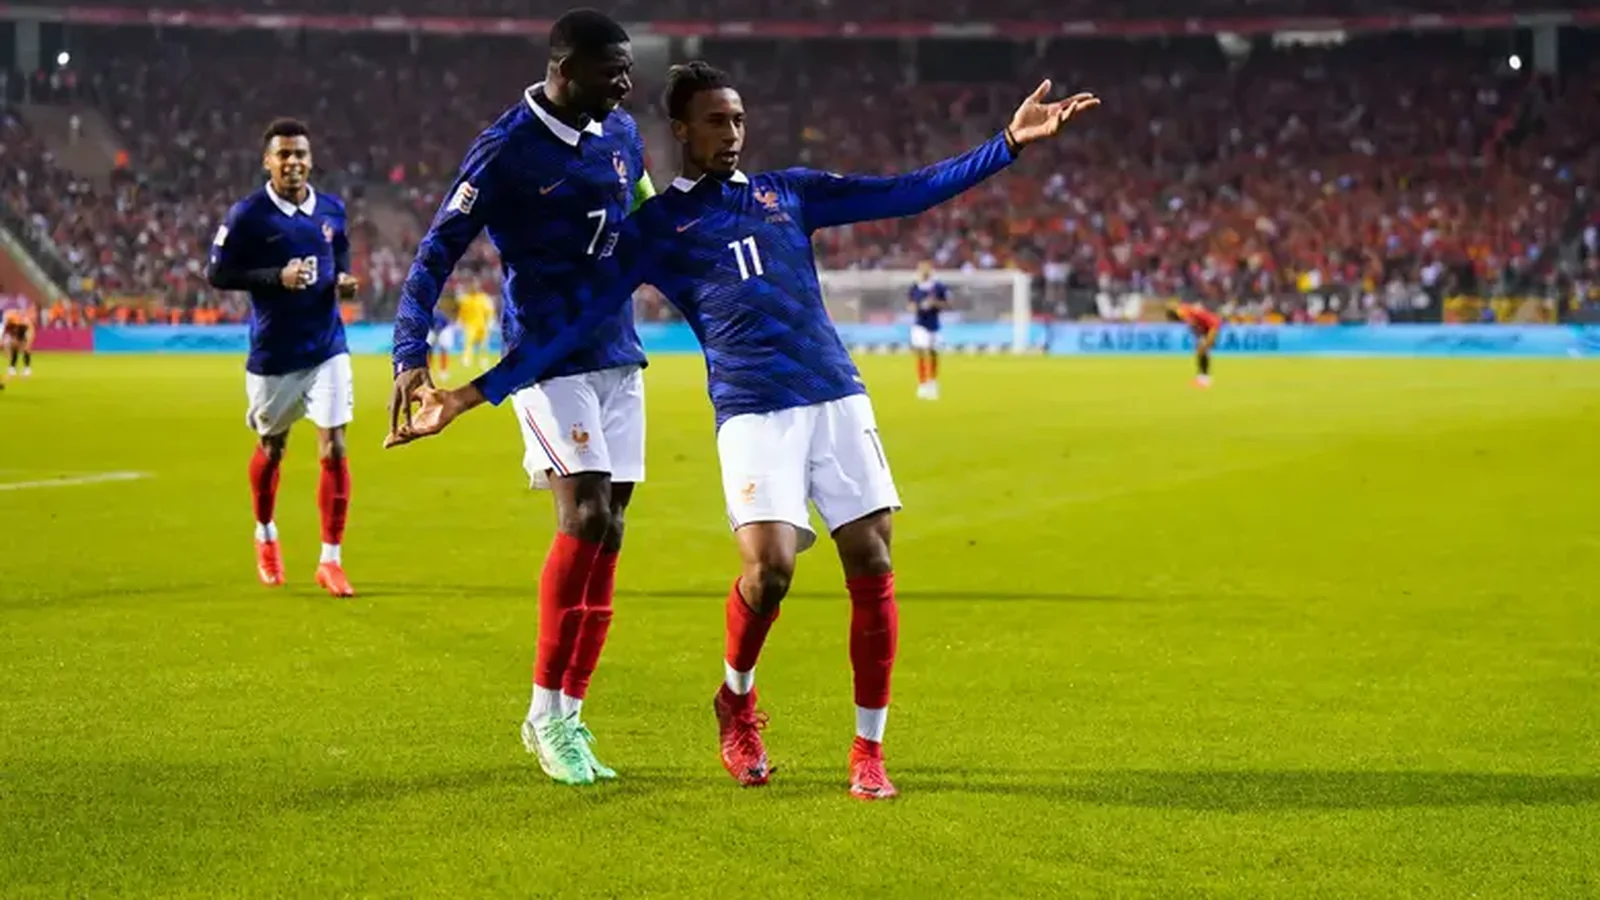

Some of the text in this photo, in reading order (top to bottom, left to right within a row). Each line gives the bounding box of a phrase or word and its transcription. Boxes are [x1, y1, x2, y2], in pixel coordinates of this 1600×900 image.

[586, 208, 607, 255] 7
[727, 236, 764, 281] 11
[1078, 331, 1280, 351] CAUSE CAOS
